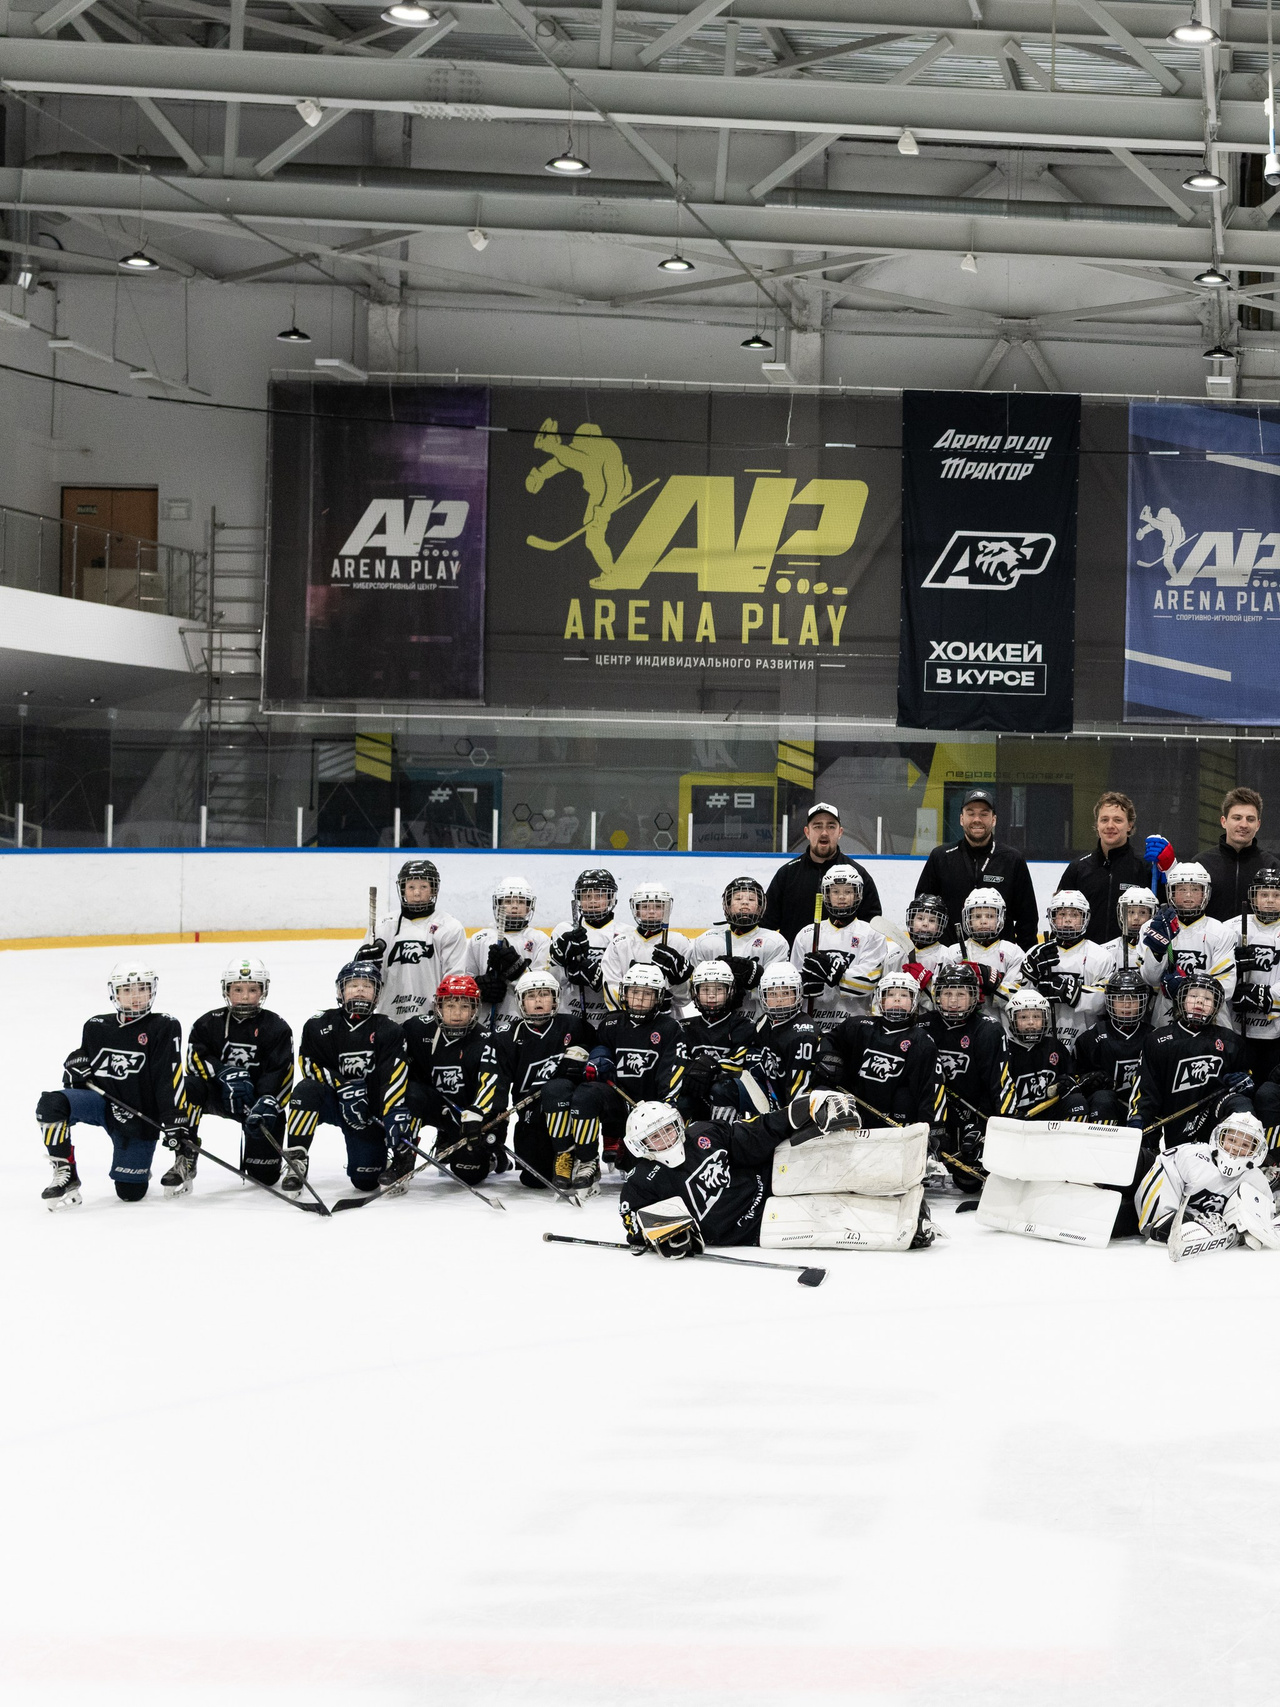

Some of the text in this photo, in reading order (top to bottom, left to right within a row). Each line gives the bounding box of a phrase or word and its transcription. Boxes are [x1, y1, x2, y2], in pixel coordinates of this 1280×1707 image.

[331, 558, 461, 581] ARENA PLAY
[352, 582, 438, 591] КИБЕРСПОРТИВНЫЙ ЦЕНТР
[1153, 590, 1227, 611] ARENA
[563, 598, 848, 647] ARENA PLAY
[1175, 614, 1263, 623] СПОРТИВНО-ИГРОВОЙ ЦЕНТР
[929, 640, 1043, 663] ХОККЕЙ
[595, 654, 815, 670] ЦЕНТР ИНДИВИДУАЛЬНОГО РАЗВИТИЯ
[936, 668, 1035, 687] В КУРСЕ
[745, 1053, 763, 1063] CC
[226, 1070, 251, 1081] CC
[342, 1090, 367, 1100] CC
[245, 1157, 281, 1166] BAUER
[455, 1163, 481, 1171] CCM
[115, 1165, 150, 1176] BAUER
[356, 1166, 382, 1174] CCM
[1222, 1165, 1233, 1177] 30
[1182, 1237, 1227, 1258] BAUER
